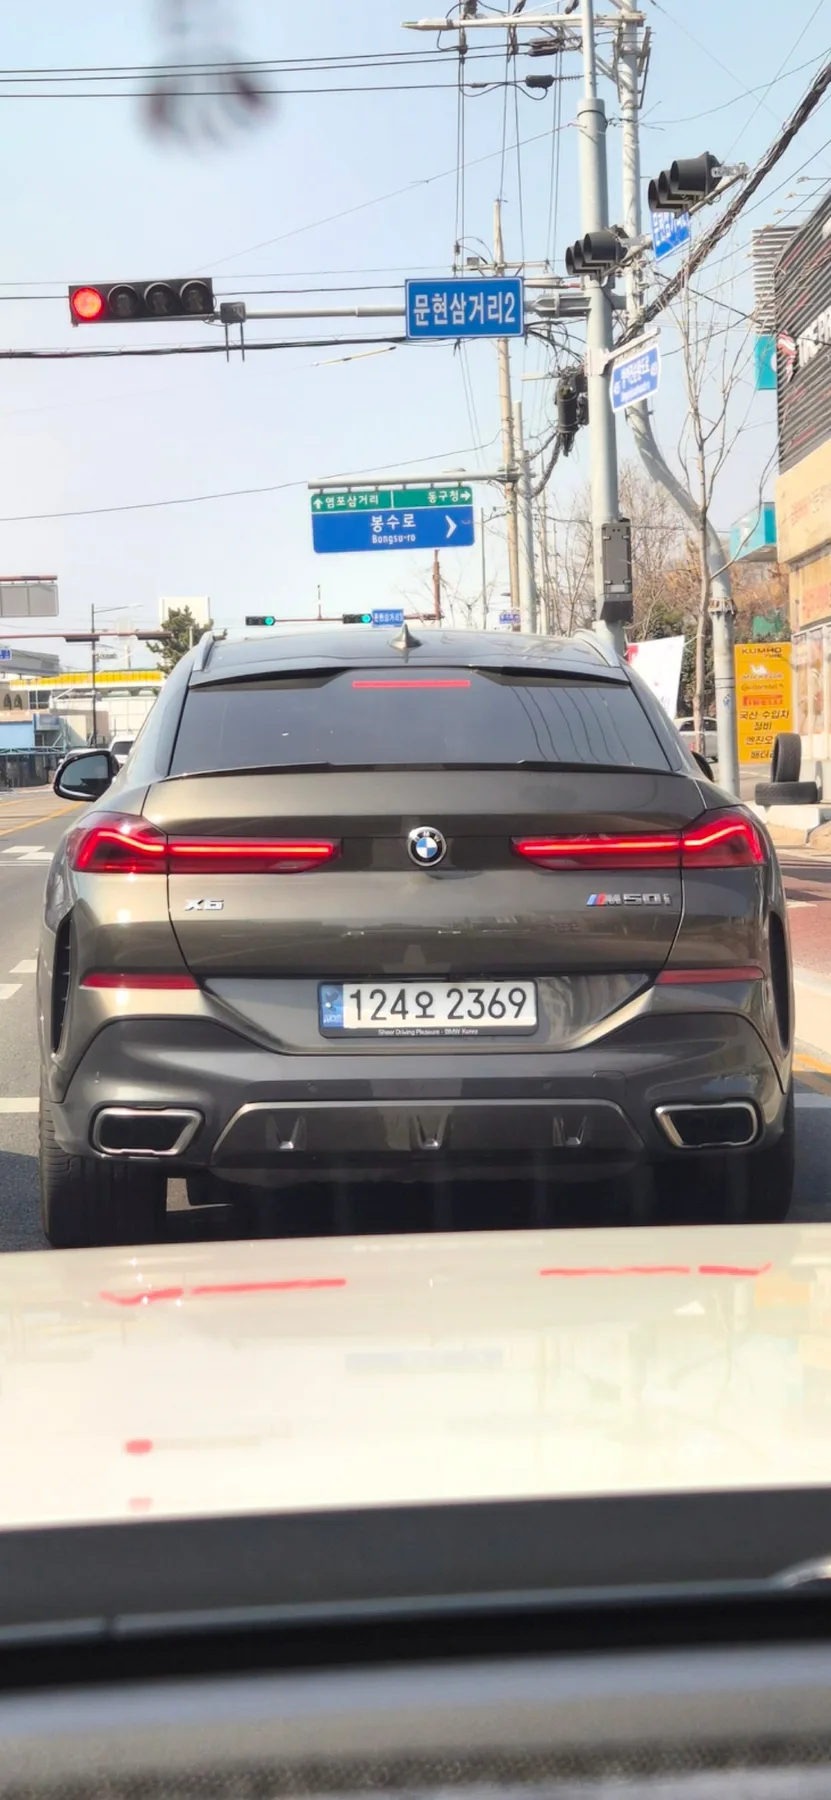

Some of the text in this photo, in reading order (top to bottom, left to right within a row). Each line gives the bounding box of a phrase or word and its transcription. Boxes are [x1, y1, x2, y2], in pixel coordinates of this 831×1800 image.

[413, 291, 516, 326] 문현삼거리2
[325, 494, 379, 508] 염포삼거리
[427, 490, 459, 504] 동구청
[370, 513, 416, 533] 봉수로
[372, 533, 416, 545] Bongsu-ro
[741, 646, 782, 654] KUMHO
[740, 710, 789, 720] 국산 수입차
[753, 721, 772, 731] 정비
[183, 898, 224, 911] X6
[349, 987, 527, 1021] 124오 2369
